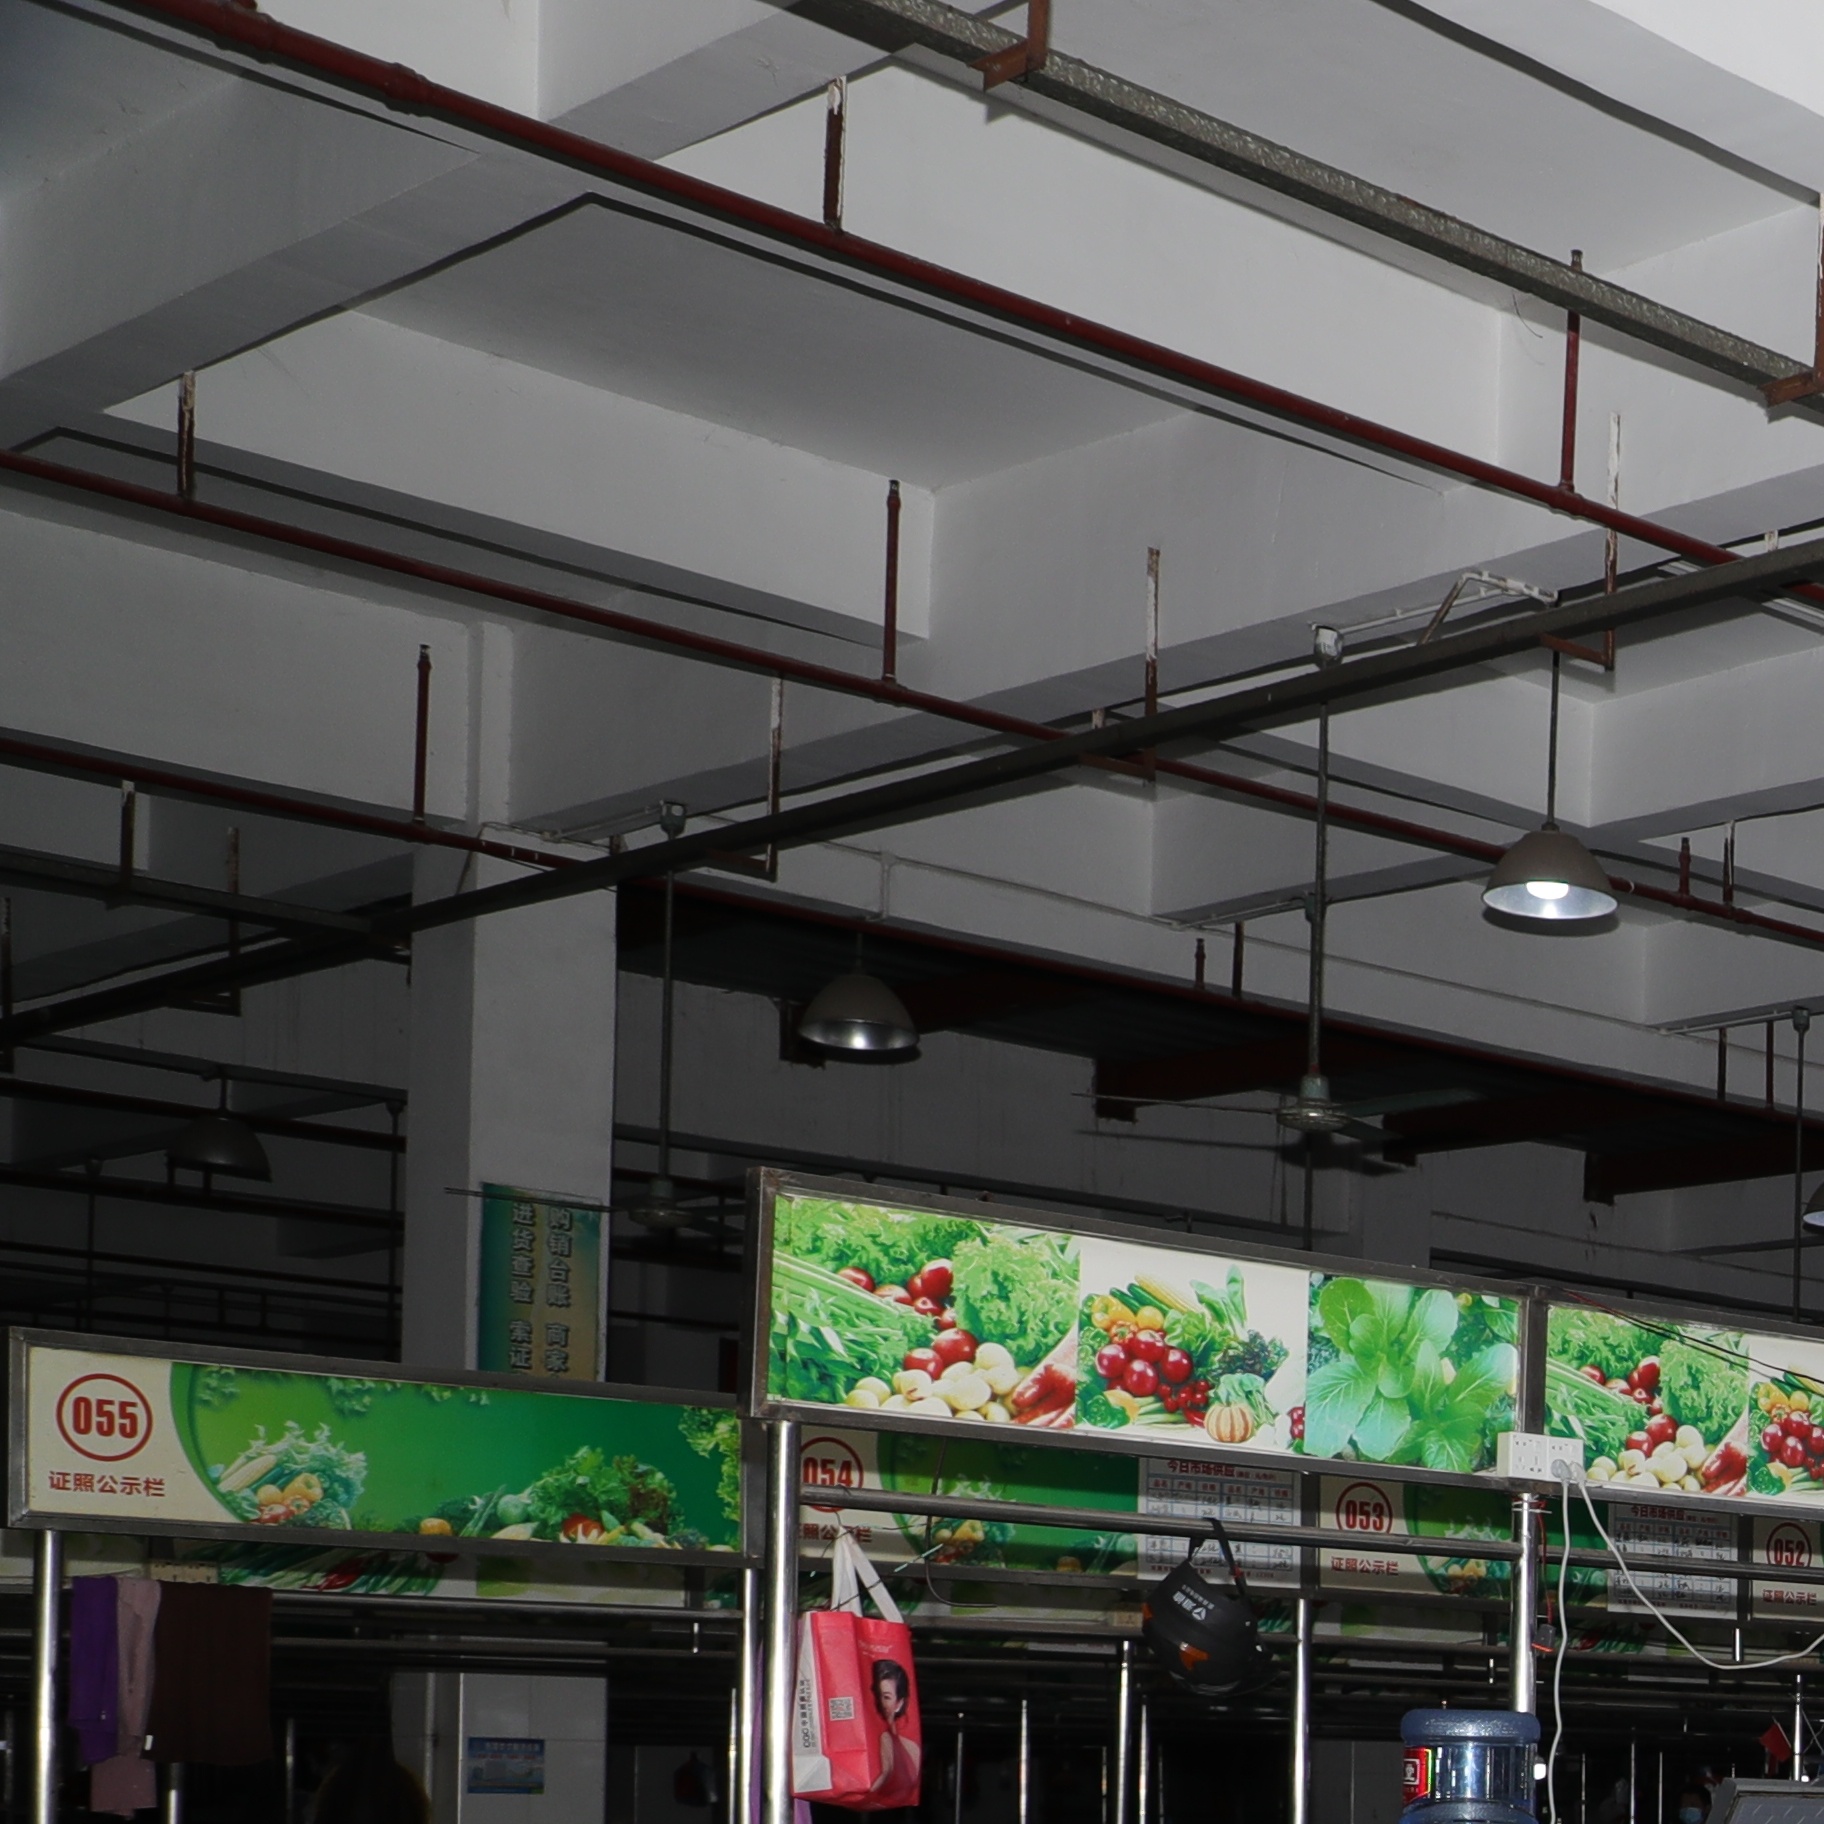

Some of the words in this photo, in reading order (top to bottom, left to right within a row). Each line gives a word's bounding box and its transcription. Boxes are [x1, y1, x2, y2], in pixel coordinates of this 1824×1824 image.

[73, 1396, 138, 1439] 055
[48, 1470, 166, 1498] 证照公示栏
[803, 1457, 852, 1487] 054
[1345, 1500, 1384, 1531] 053
[799, 1523, 872, 1542] 照公栏
[1331, 1556, 1399, 1576] 证照公示栏
[1774, 1539, 1805, 1567] 052
